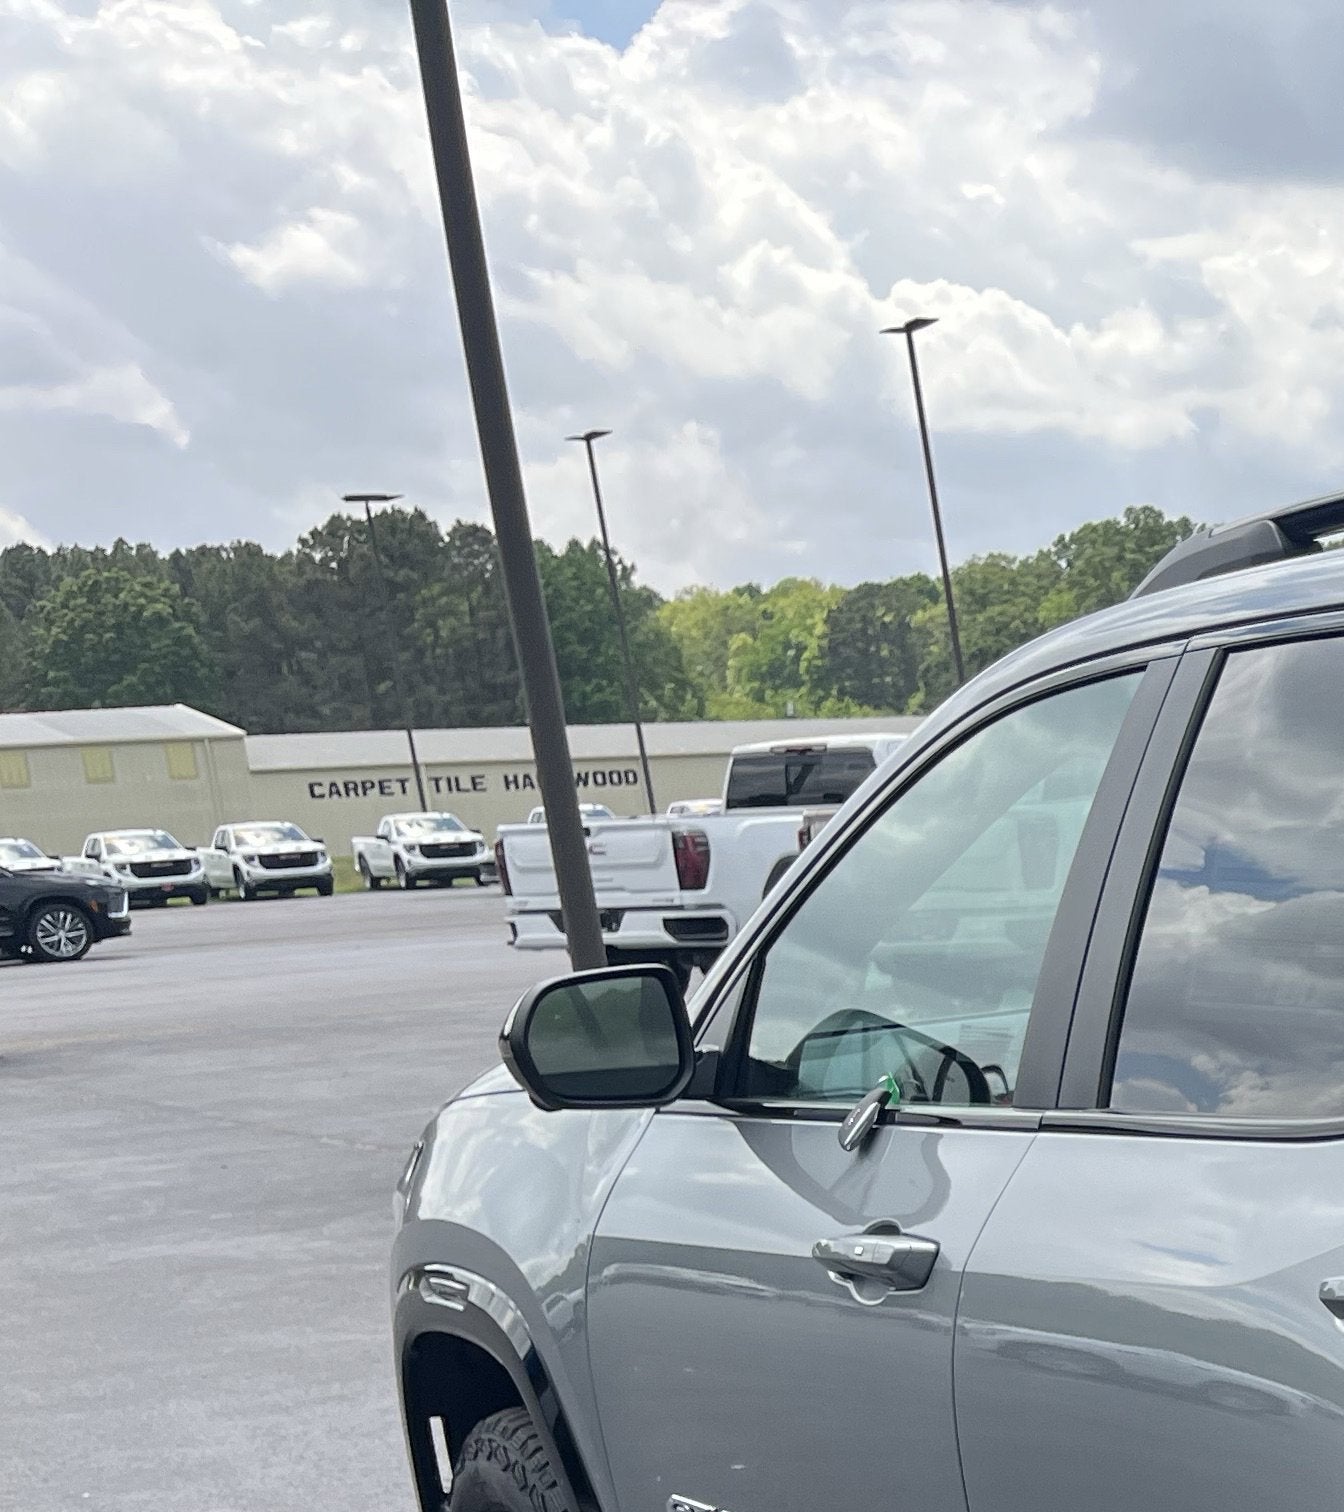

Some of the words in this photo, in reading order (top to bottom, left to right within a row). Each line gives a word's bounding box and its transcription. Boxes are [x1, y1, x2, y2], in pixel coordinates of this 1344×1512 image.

[308, 777, 409, 799] CARPET
[429, 774, 487, 793] TILE
[504, 769, 638, 791] HAWOOD
